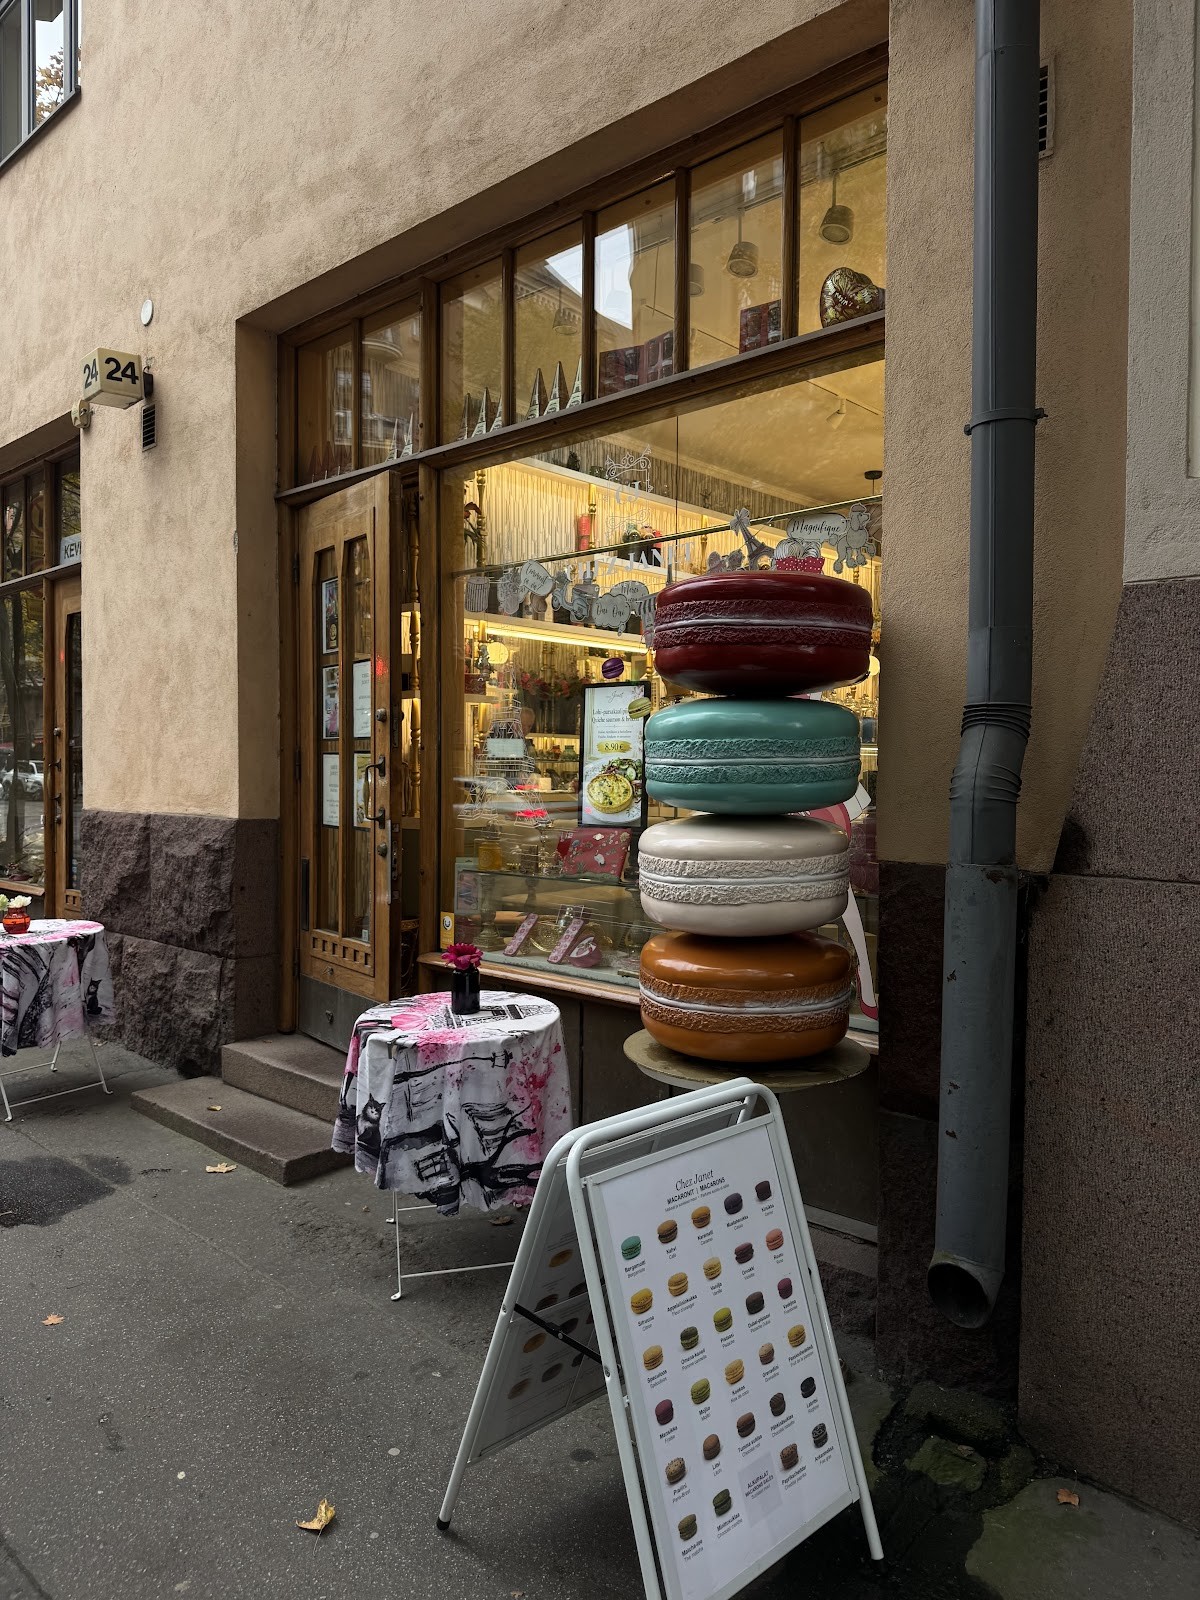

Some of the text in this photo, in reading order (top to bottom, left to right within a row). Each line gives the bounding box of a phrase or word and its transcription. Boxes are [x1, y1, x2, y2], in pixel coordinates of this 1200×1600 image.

[83, 358, 99, 389] 24
[105, 357, 139, 385] 24
[791, 518, 841, 536] Magnifique
[674, 1168, 714, 1192] Chez Janet
